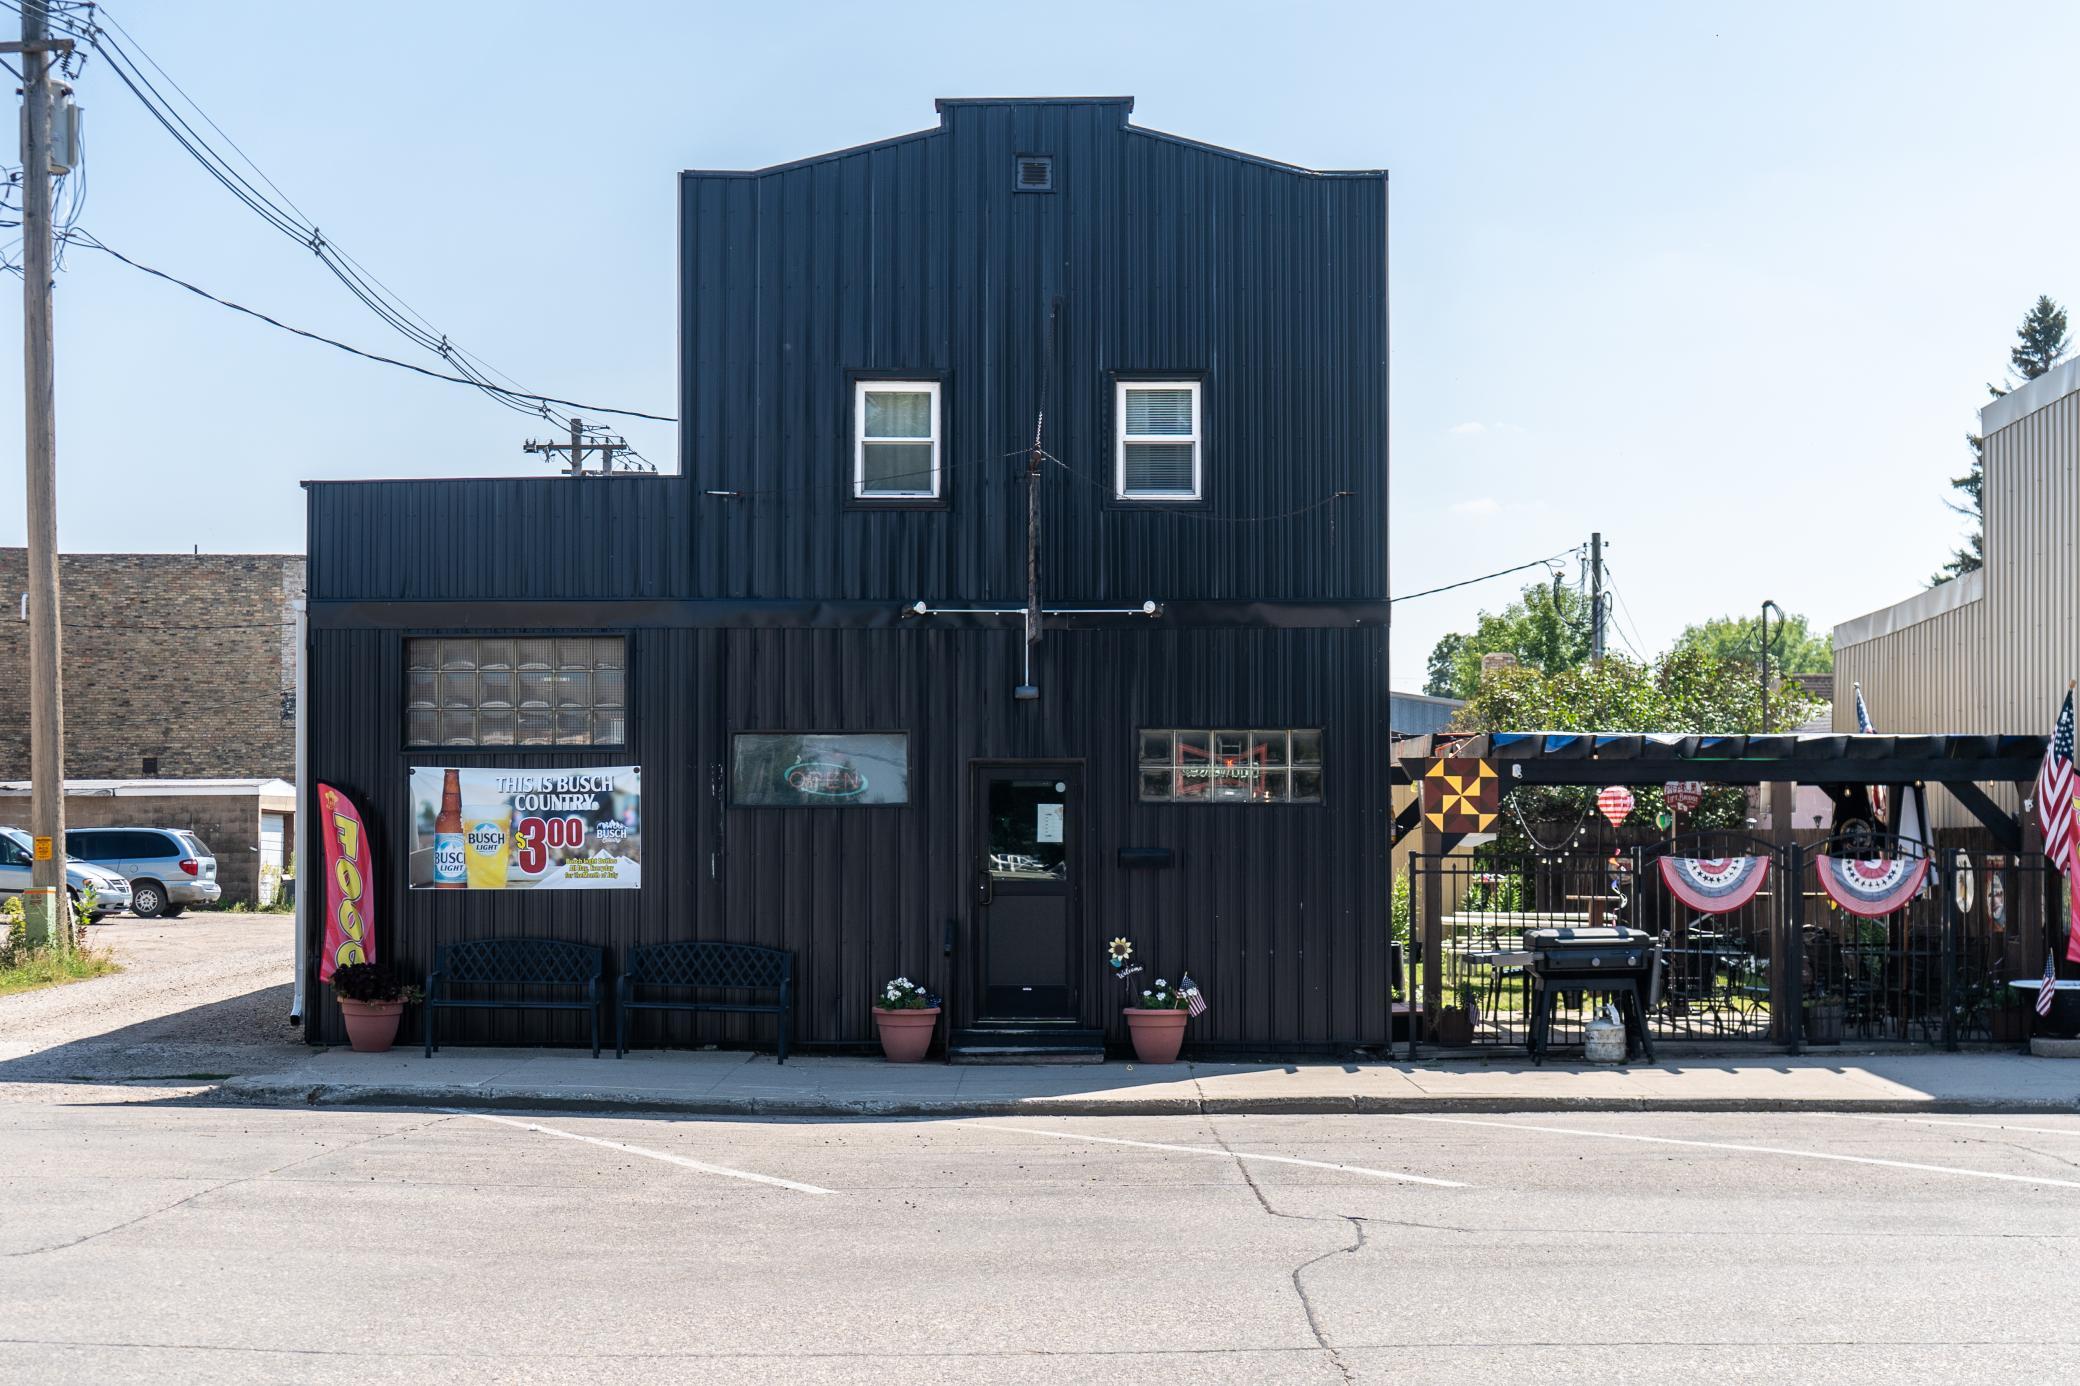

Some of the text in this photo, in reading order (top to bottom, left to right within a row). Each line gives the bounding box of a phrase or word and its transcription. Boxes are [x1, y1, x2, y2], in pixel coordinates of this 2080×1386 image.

[496, 775, 615, 793] THIS IS BUSCH
[788, 770, 859, 789] OPEN
[468, 833, 505, 844] BUSCH
[597, 829, 627, 838] BUSCH
